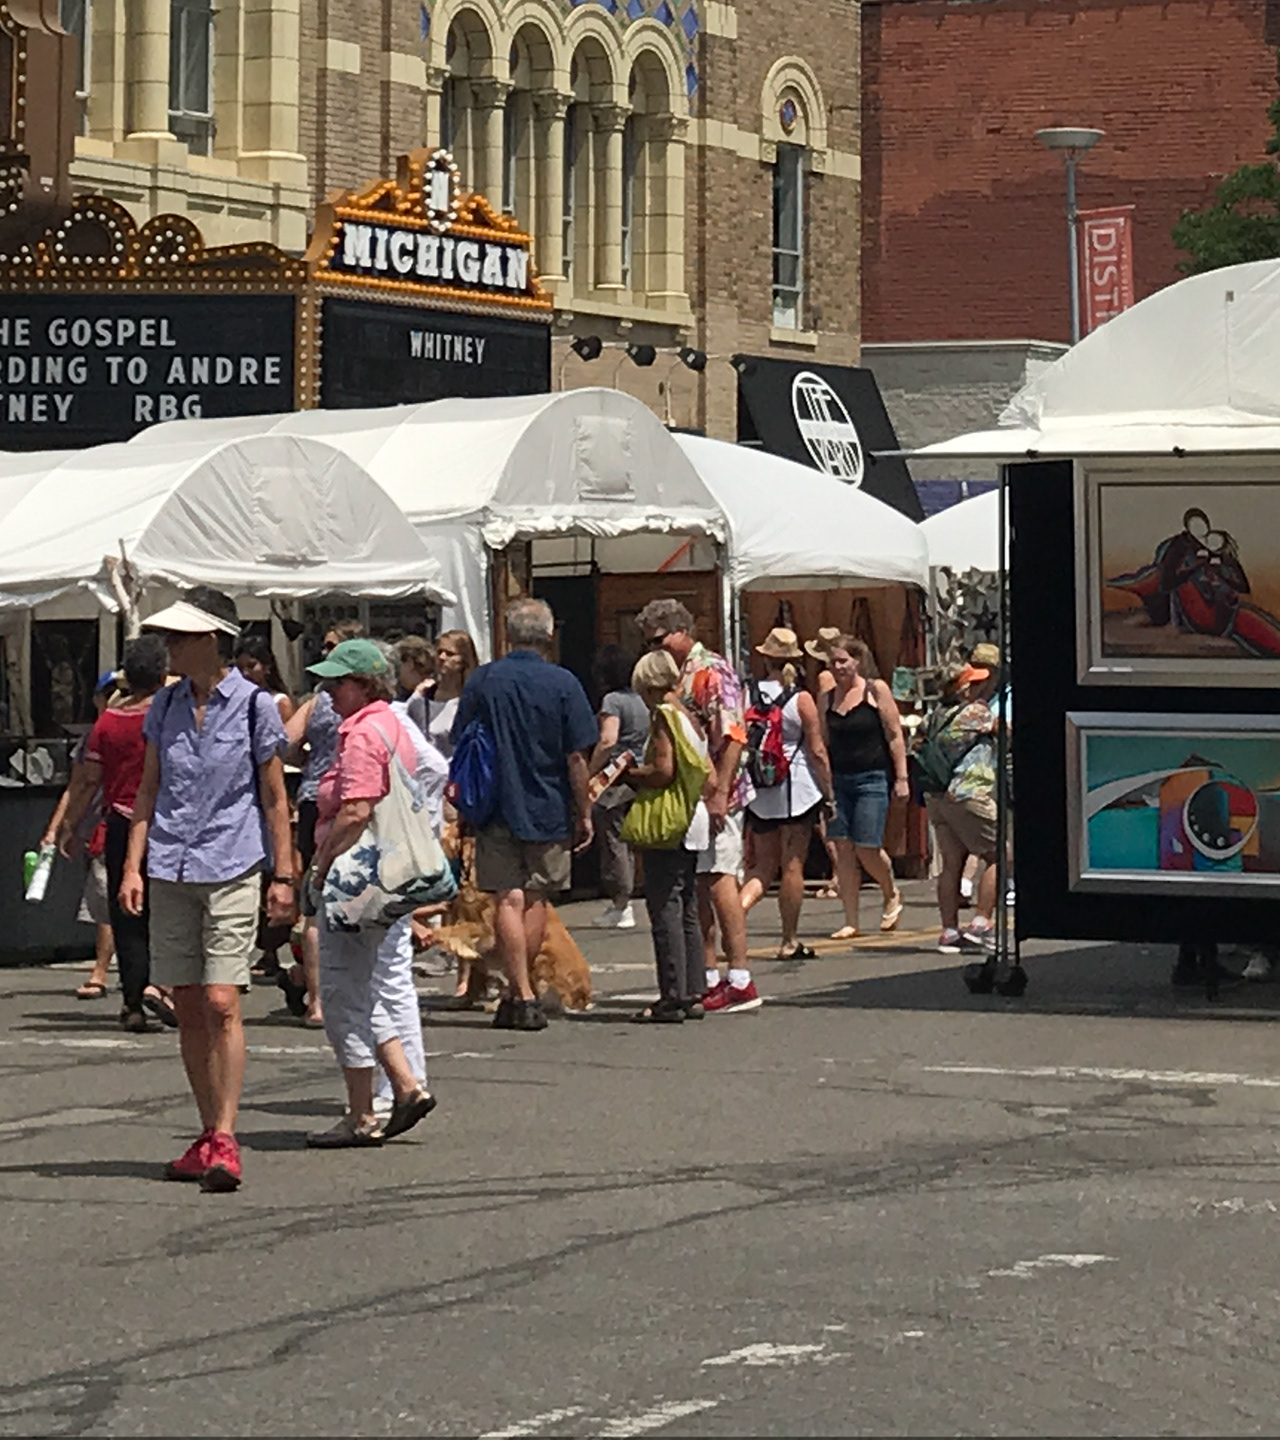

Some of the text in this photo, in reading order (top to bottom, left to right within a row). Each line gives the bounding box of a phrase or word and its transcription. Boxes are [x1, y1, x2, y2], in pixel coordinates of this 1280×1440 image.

[342, 222, 530, 290] MICHIGAN
[48, 318, 177, 347] GOSPEL
[410, 330, 486, 364] WHITNEY
[105, 357, 148, 385] TO
[166, 357, 281, 385] ANDRE
[134, 394, 203, 422] RBG
